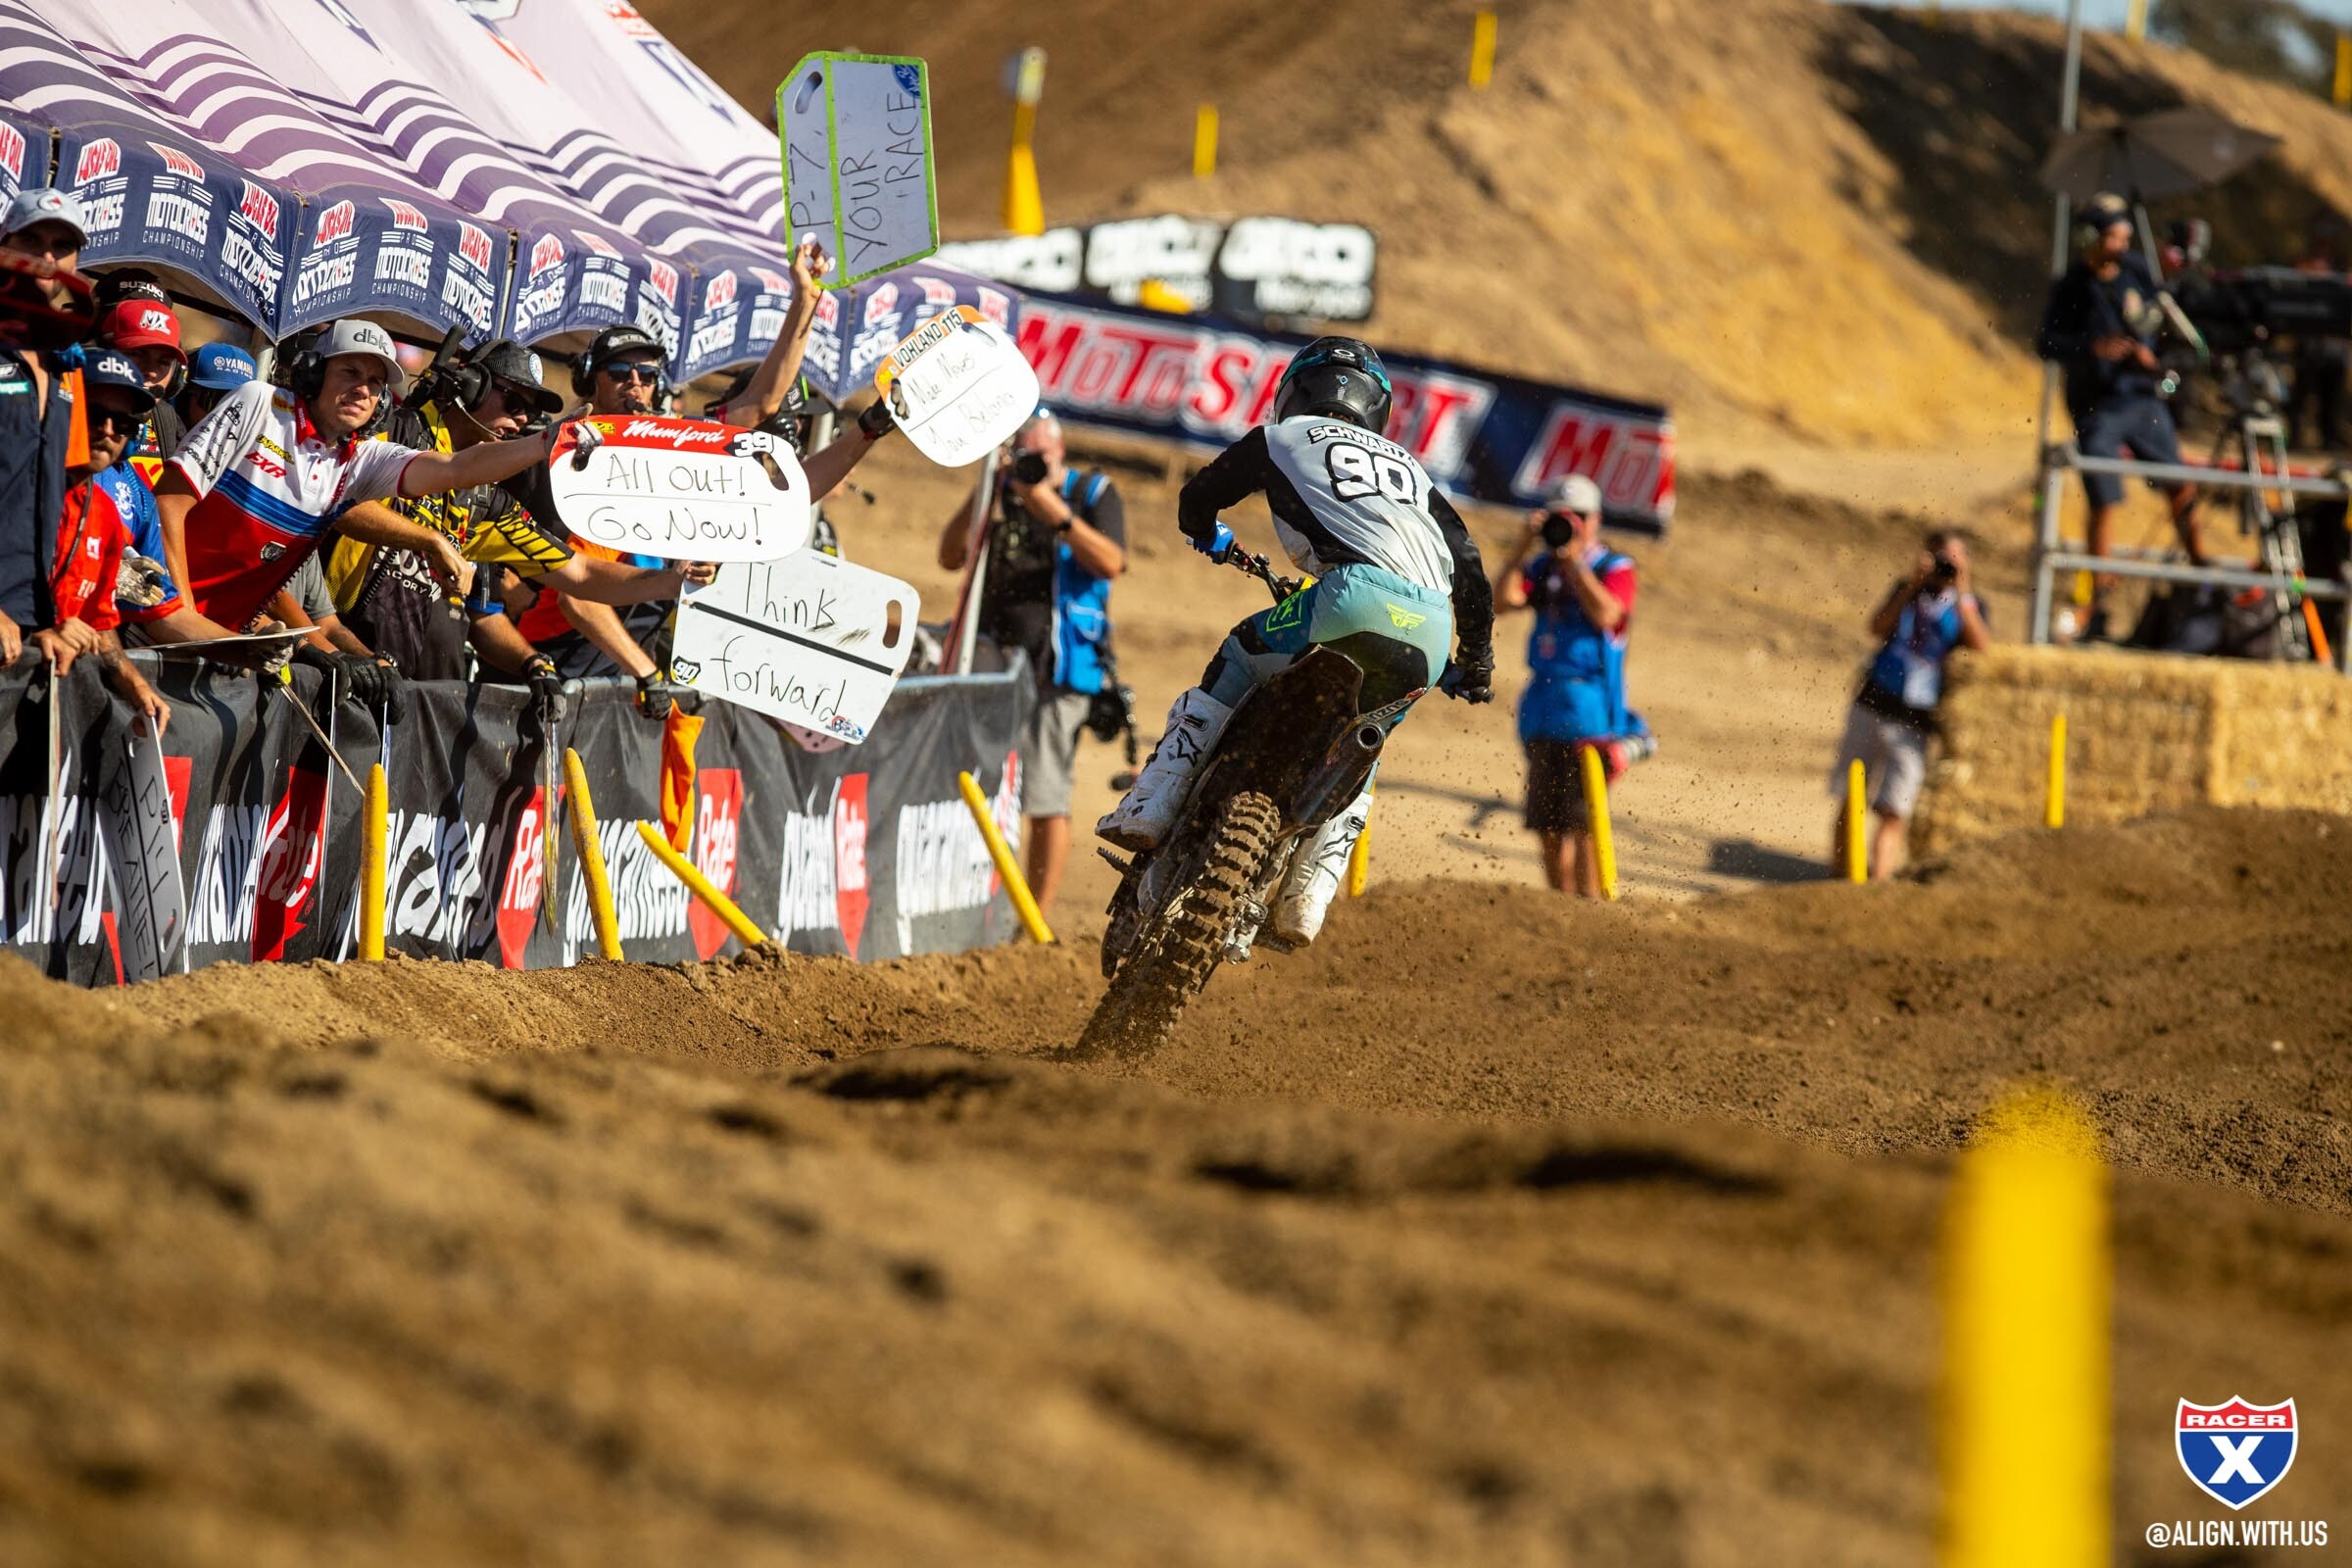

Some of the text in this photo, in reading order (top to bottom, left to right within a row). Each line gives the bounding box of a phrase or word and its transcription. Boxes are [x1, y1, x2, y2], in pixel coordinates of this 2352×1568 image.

[175, 177, 193, 196] PRO
[145, 192, 211, 245] MOTOCROSS
[840, 149, 888, 265] YOUR
[142, 230, 205, 261] CHAMPIONSHIP
[400, 232, 416, 246] PRO
[374, 246, 431, 289] MOTOCROSS
[371, 281, 427, 304] CHAMPIONSHIP
[139, 309, 172, 335] MX
[353, 327, 389, 356] dbk
[893, 321, 943, 368] VOHLAND
[941, 309, 964, 333] 115
[97, 357, 137, 383] dbk
[224, 356, 254, 376] YAMAHA
[622, 419, 774, 458] Mumford 39
[607, 453, 654, 494] All
[1325, 441, 1418, 506] 90
[588, 506, 762, 545] Go Now!
[745, 562, 837, 629] Think
[673, 659, 700, 680] 90
[710, 634, 847, 722] forward
[695, 793, 735, 893] Rate
